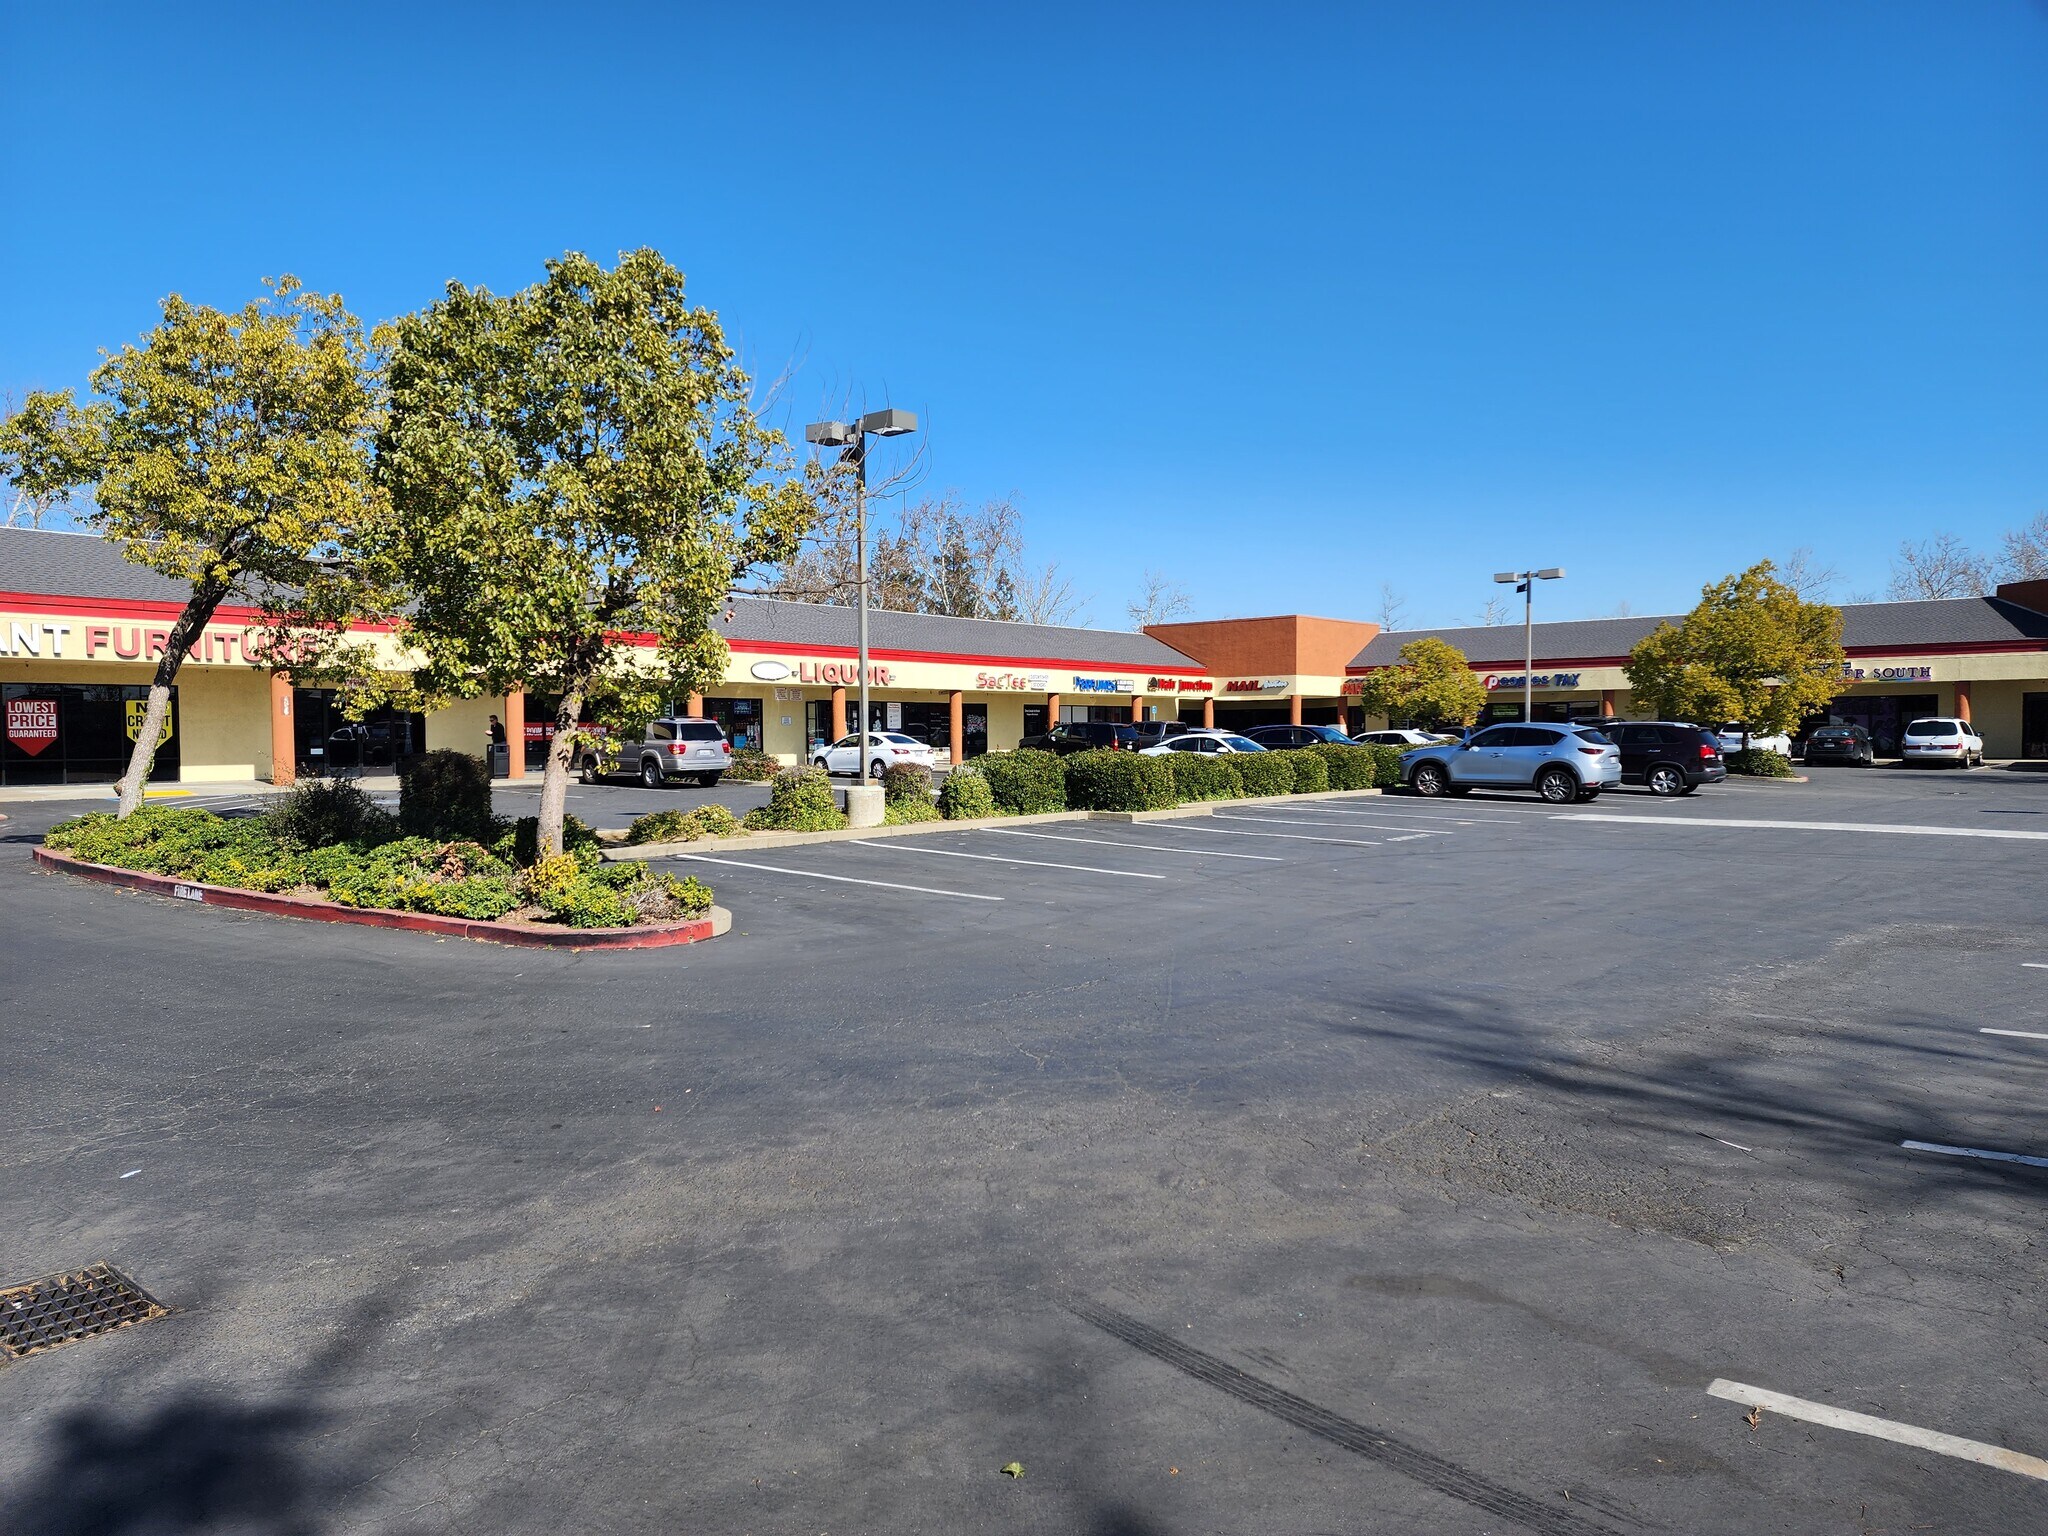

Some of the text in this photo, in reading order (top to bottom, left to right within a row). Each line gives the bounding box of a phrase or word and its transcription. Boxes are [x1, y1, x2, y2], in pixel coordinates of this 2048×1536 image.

[86, 625, 317, 664] FURITURE
[1874, 667, 1931, 678] SOUTH
[1555, 673, 1581, 686] TAX
[1227, 680, 1262, 691] NAIL
[8, 702, 56, 713] LOWEST
[10, 715, 54, 727] PRICE
[128, 715, 170, 726] CRT
[10, 730, 57, 738] GUARANTEED
